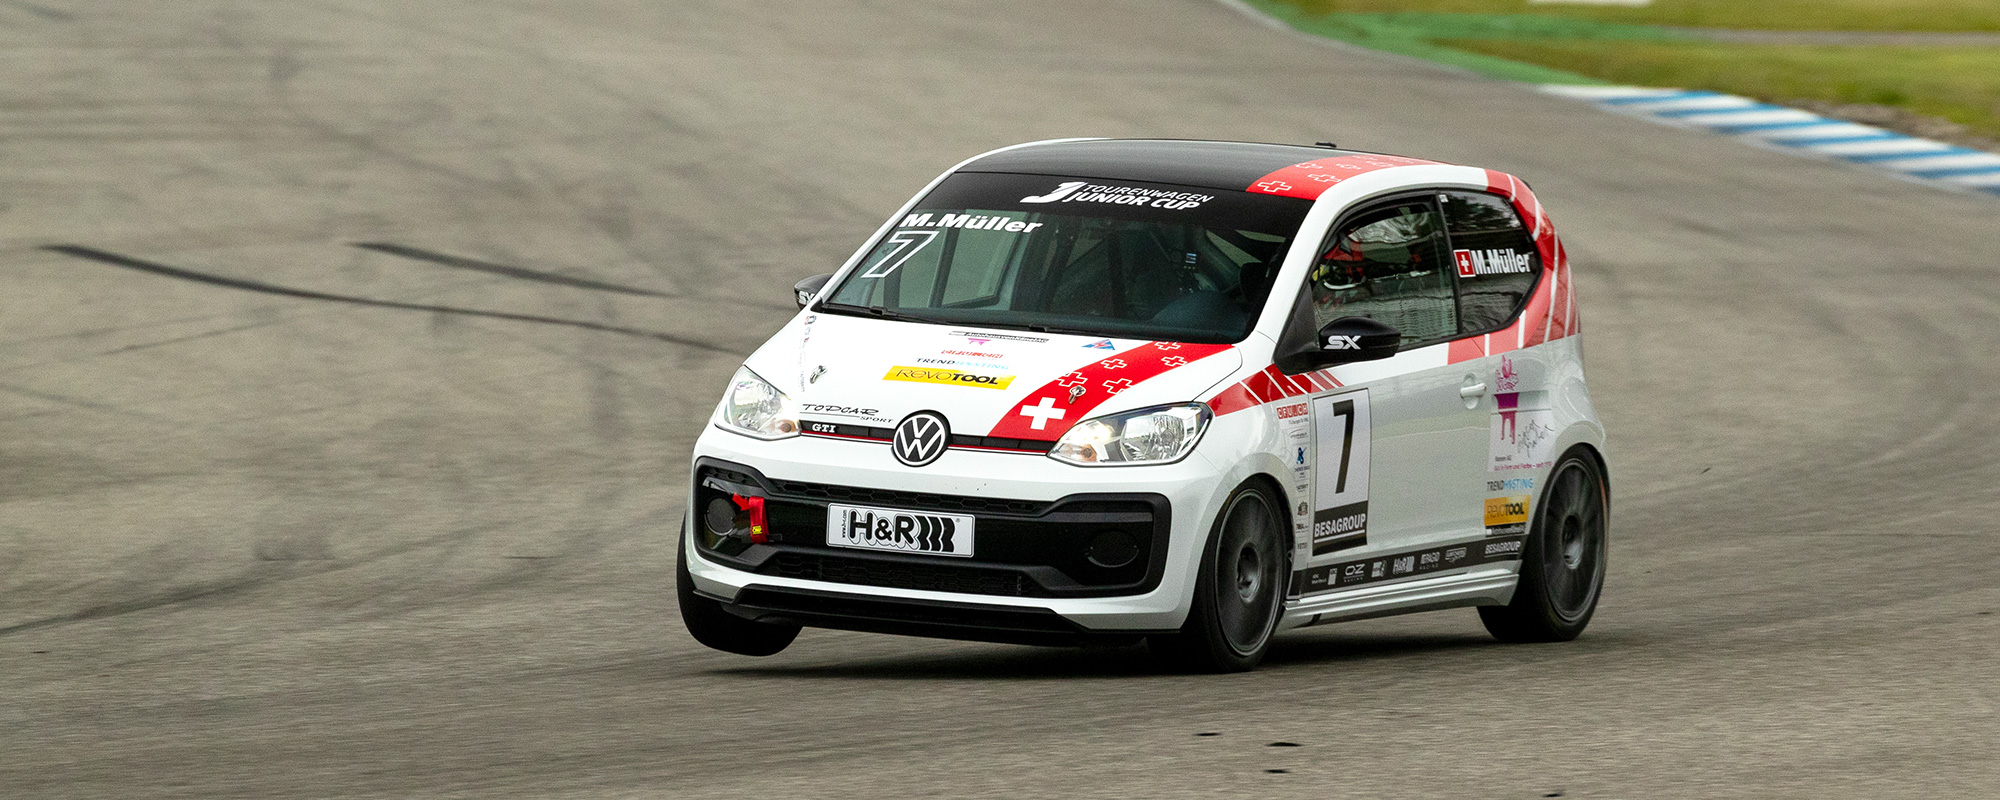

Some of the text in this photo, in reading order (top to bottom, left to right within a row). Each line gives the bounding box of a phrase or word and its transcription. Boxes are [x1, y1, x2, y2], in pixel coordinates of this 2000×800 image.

[1061, 191, 1201, 211] JUNIOR CUP
[1083, 184, 1215, 203] TOURENWAGEN
[899, 213, 1043, 233] M.Müller
[860, 230, 940, 279] 7
[1470, 248, 1532, 275] M.Müller
[1323, 335, 1362, 350] SX
[802, 403, 880, 417] TOPCAR
[811, 422, 837, 434] GTI
[859, 416, 894, 424] SPORT
[1332, 399, 1355, 494] 7
[848, 509, 916, 548] H&R
[1314, 513, 1367, 538] BESAGROUP
[1485, 541, 1521, 555] BESAGROUP
[1344, 563, 1366, 576] OZ
